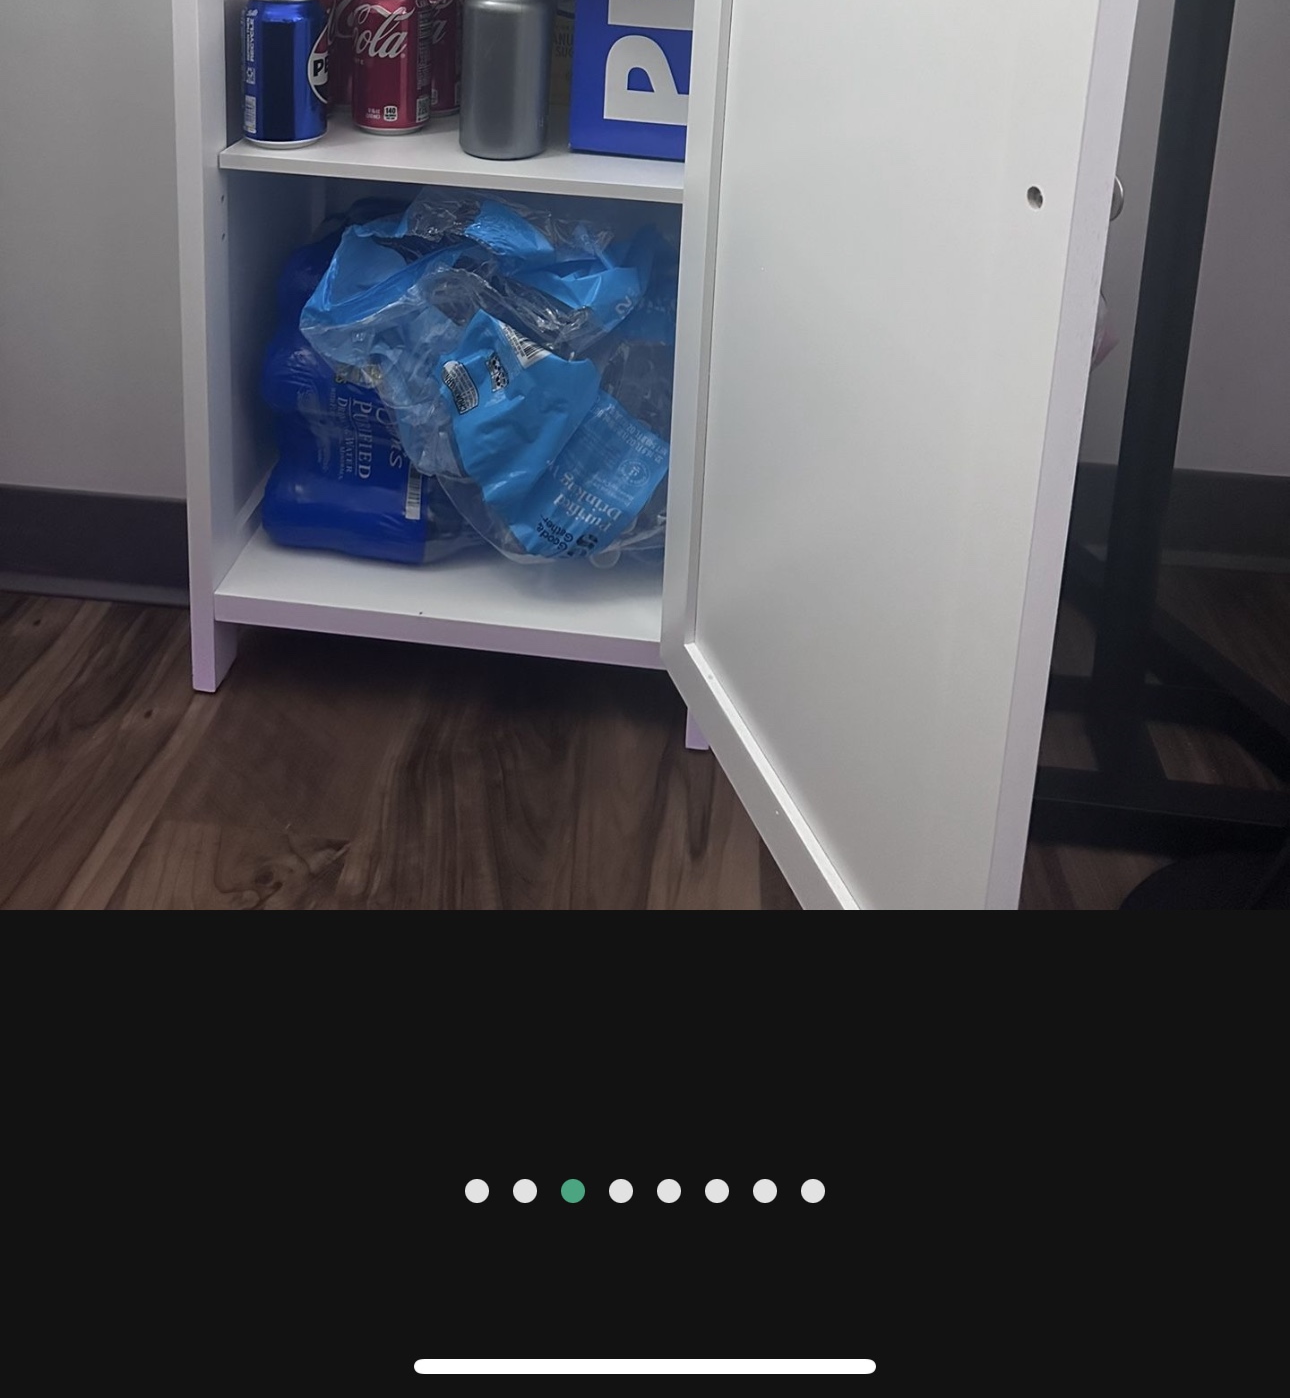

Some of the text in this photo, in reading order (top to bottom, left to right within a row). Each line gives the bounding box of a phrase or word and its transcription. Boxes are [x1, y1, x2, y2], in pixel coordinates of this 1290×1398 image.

[344, 437, 355, 473] WATER
[352, 398, 373, 480] PURIFIED
[543, 517, 574, 542] Gather
[553, 492, 612, 532] Purified
